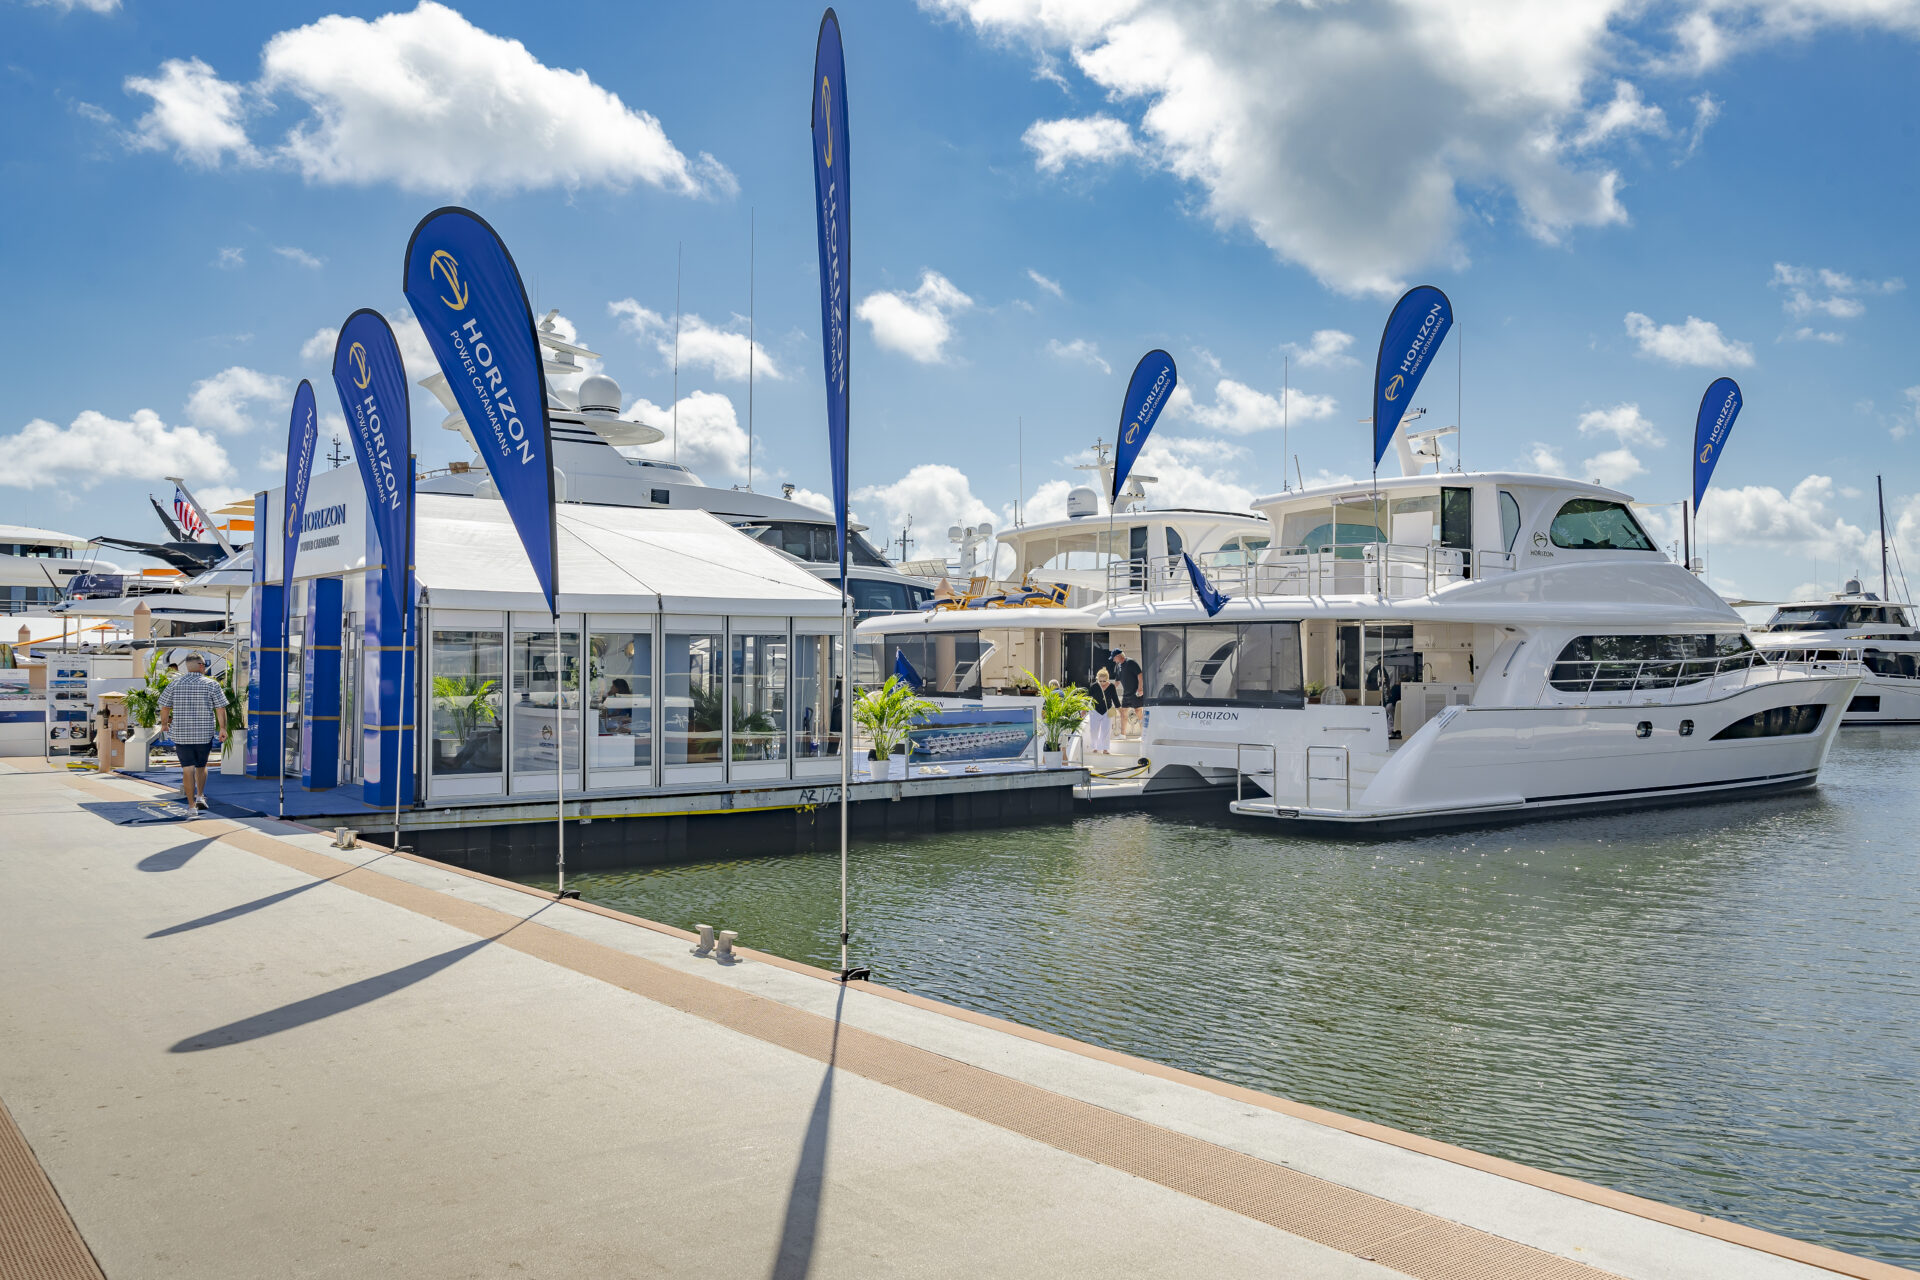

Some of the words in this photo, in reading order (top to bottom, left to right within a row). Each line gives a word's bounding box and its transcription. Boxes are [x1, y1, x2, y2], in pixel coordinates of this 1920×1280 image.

[1400, 303, 1442, 372] HORIZON
[1410, 354, 1425, 376] POWER
[1421, 316, 1445, 355] CATAMARANS
[450, 330, 476, 376] POWER
[472, 376, 512, 457] CATAMARANS
[462, 318, 535, 465] HORIZON
[1137, 366, 1170, 421] HORIZON
[1710, 390, 1736, 442] HORIZON
[295, 407, 313, 500] HORIZON
[355, 404, 369, 440] POWER
[365, 440, 387, 504] CATAMARANS
[364, 394, 401, 511] HORIZON
[1190, 711, 1240, 721] HORIZON
